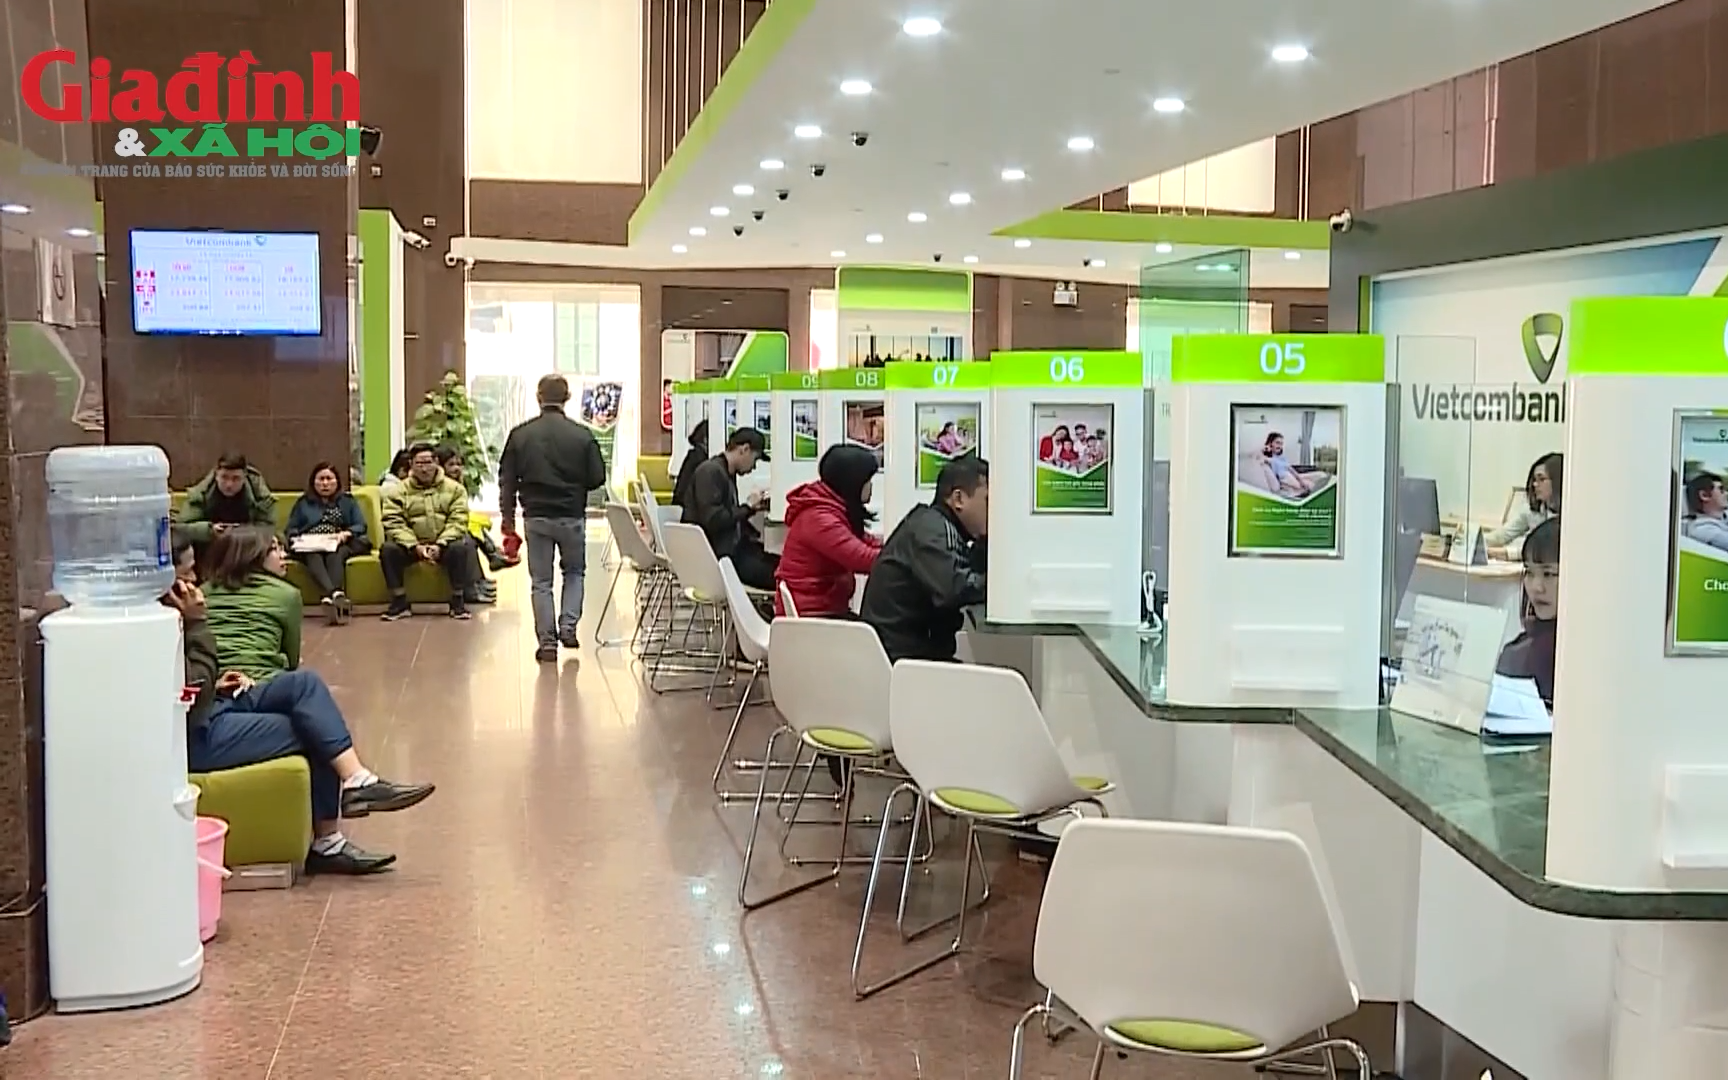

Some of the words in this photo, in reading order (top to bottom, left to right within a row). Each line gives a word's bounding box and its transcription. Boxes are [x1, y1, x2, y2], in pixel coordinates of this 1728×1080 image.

[1050, 356, 1084, 382] 06
[1259, 342, 1306, 375] 05
[855, 371, 878, 387] 08
[933, 364, 959, 386] 07
